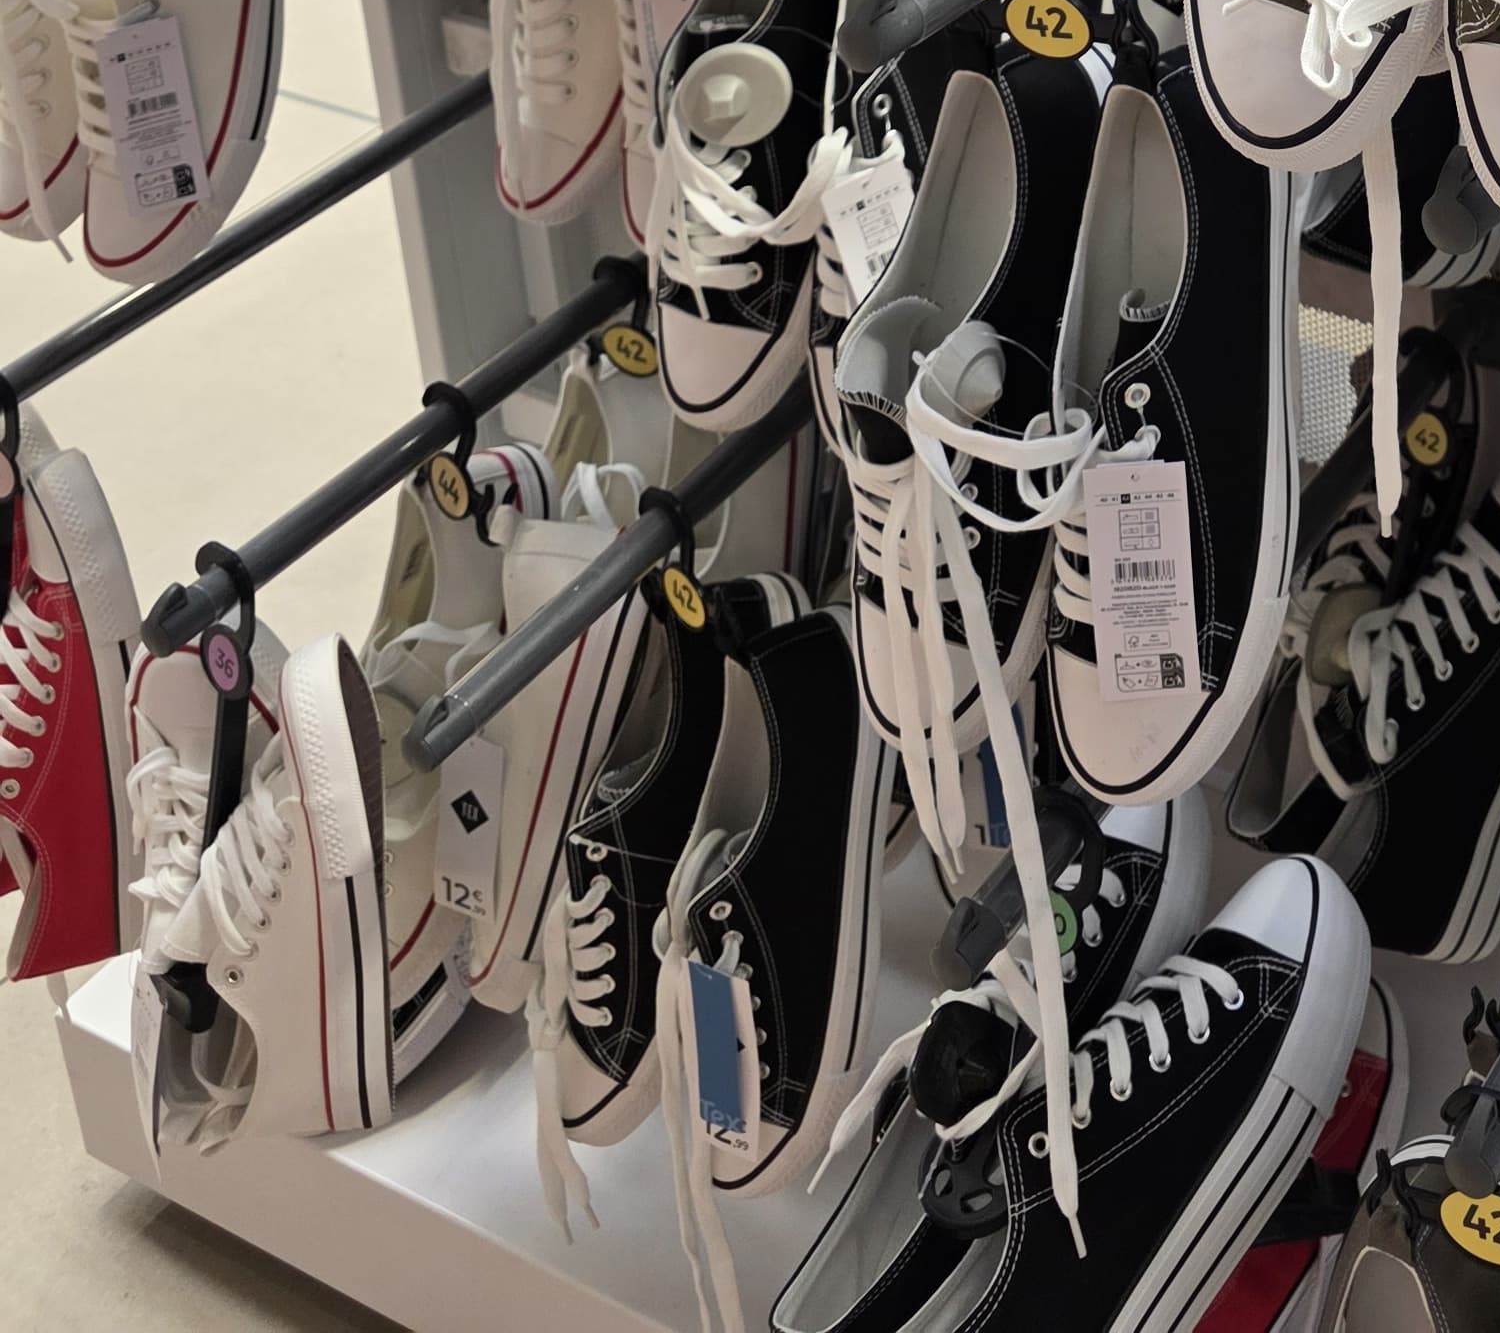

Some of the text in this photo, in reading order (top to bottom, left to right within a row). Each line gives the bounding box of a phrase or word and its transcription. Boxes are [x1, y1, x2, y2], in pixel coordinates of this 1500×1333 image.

[1025, 5, 1073, 40] 42
[615, 335, 648, 364] 42
[1415, 428, 1440, 454] 42
[438, 469, 460, 504] 44
[672, 578, 697, 614] 42
[215, 646, 234, 679] 36
